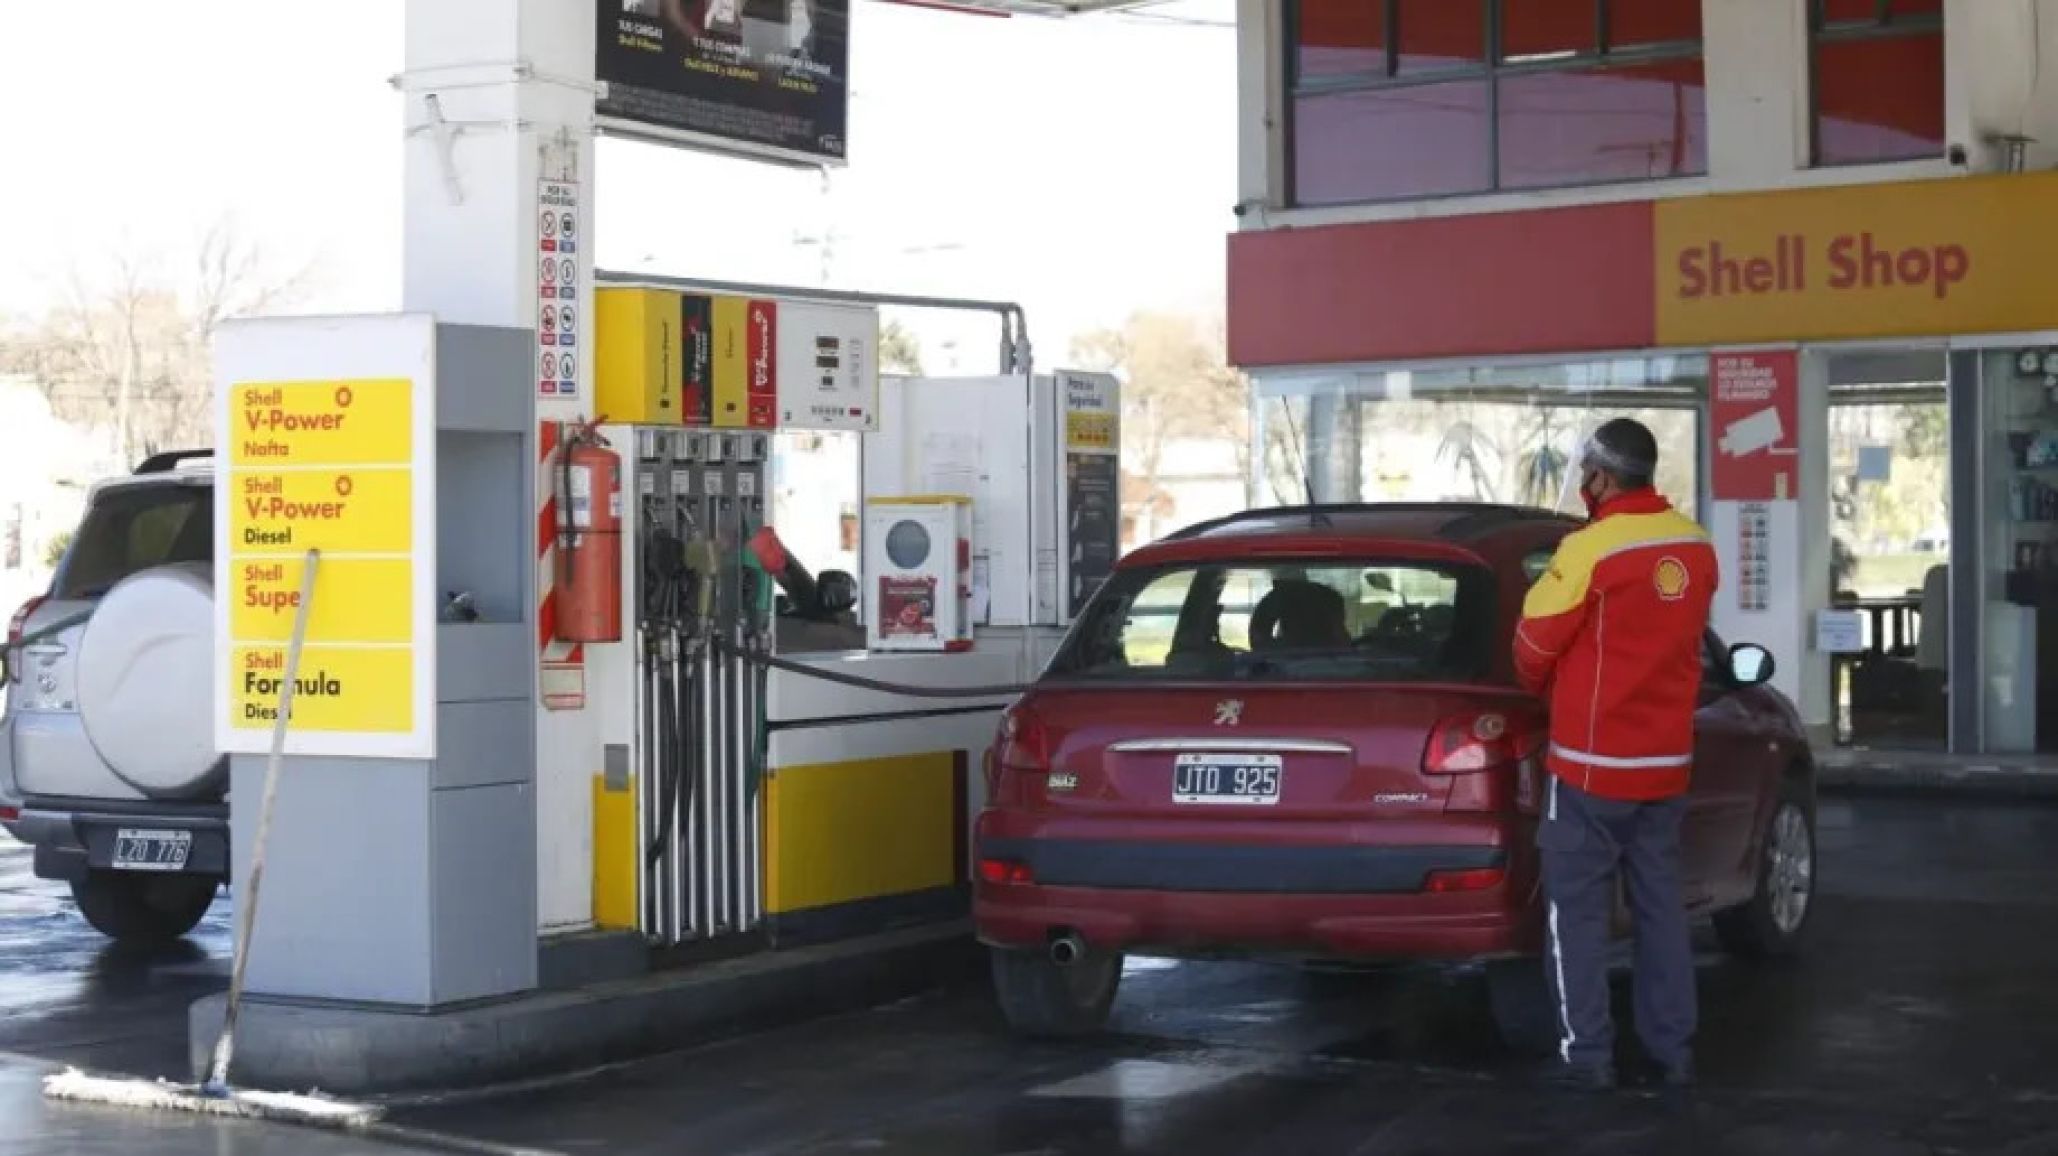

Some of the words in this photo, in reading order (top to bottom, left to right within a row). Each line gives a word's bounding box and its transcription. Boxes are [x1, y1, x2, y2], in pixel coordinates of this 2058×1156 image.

[1679, 234, 1805, 298] Shell
[1826, 231, 1970, 300] Shop
[245, 389, 282, 406] Shell
[245, 409, 345, 431] V-Power
[244, 440, 289, 457] Nafta
[245, 477, 282, 494] Shell
[245, 497, 345, 519] V-Power
[244, 527, 292, 545] Diesel
[245, 564, 282, 581] Shell
[245, 584, 304, 614] Supe
[245, 652, 282, 668] Shell
[245, 703, 292, 719] Diesl
[1234, 766, 1277, 794] 925
